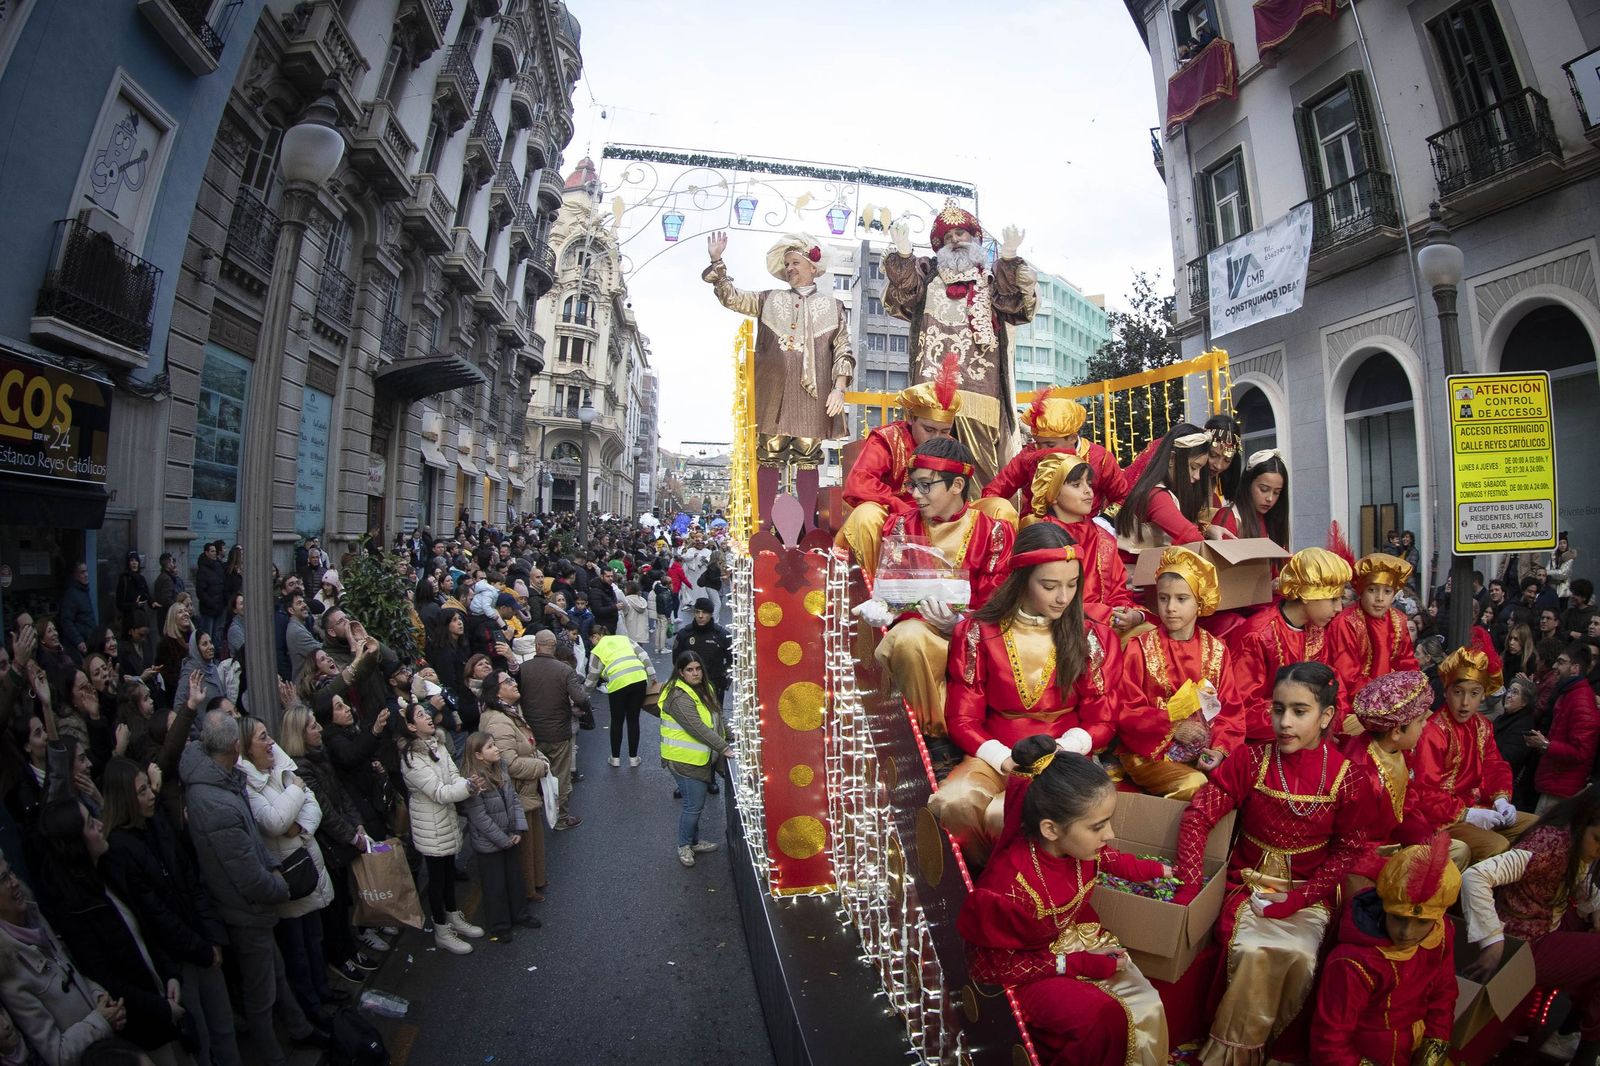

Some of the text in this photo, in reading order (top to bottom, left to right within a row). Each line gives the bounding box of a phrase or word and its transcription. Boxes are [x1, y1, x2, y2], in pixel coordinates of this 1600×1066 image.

[1246, 270, 1265, 288] CMB
[1225, 289, 1278, 317] CONSTRUIMOS
[1475, 381, 1541, 395] ATENCIÓN
[0, 369, 74, 433] COS
[1485, 396, 1534, 406] CONTROL
[1478, 407, 1543, 418] DE ACCESOS
[1460, 424, 1545, 436] ACCESO RESTRINGIDO
[49, 424, 72, 452] 24
[1461, 437, 1546, 450] CALLE REYES CATÓLICOS
[38, 451, 65, 474] Reyes
[66, 455, 107, 476] Católicos
[1461, 481, 1482, 489] VIERNES
[1460, 490, 1483, 498] DOMINGOS
[1469, 505, 1499, 513] EXCEPTO
[1500, 503, 1514, 511] BUS
[1513, 512, 1543, 520] HOTELES
[1477, 523, 1491, 531] DEL
[1520, 521, 1533, 529] TAXI
[1465, 530, 1549, 540] VEHÍCULOS AUTORIZADOS
